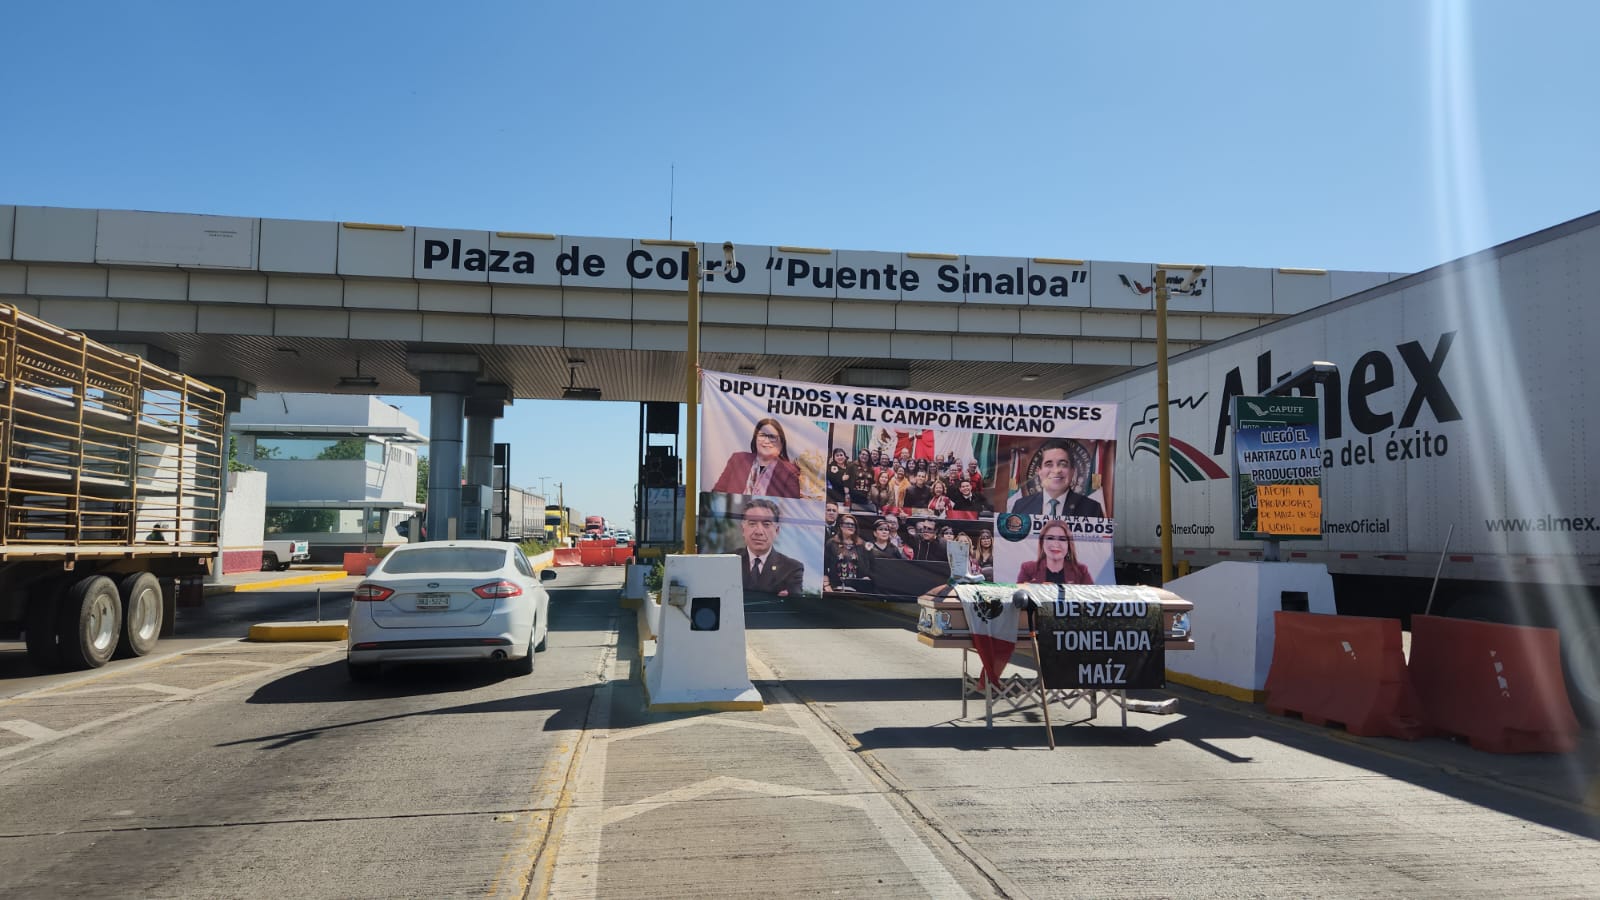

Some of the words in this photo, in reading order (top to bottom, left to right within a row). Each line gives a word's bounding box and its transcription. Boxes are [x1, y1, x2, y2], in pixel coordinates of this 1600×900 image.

[423, 239, 535, 275] Plaza
[556, 246, 606, 277] de
[719, 378, 832, 404] DIPUTADOS
[837, 390, 849, 405] Y
[853, 392, 969, 414] SENADORES
[973, 401, 1102, 422] SINALOENSES
[1269, 405, 1304, 414] CAPUFE
[767, 399, 848, 421] HUNDEN
[852, 405, 877, 423] AL
[881, 408, 951, 428] CAMPO
[955, 415, 1055, 434] MEXICANO
[1262, 427, 1293, 444] LLEGÓ
[1297, 429, 1309, 443] EL
[1243, 450, 1297, 463] HARTAZGO
[1300, 448, 1308, 460] A
[1341, 437, 1375, 466] del
[1385, 430, 1449, 461] éxito
[1033, 521, 1113, 534] DITADOS
[1054, 599, 1080, 617] DE
[1086, 599, 1147, 617] $7.200
[1053, 630, 1151, 652] TONELADA
[1078, 658, 1127, 685] MAÍZ
